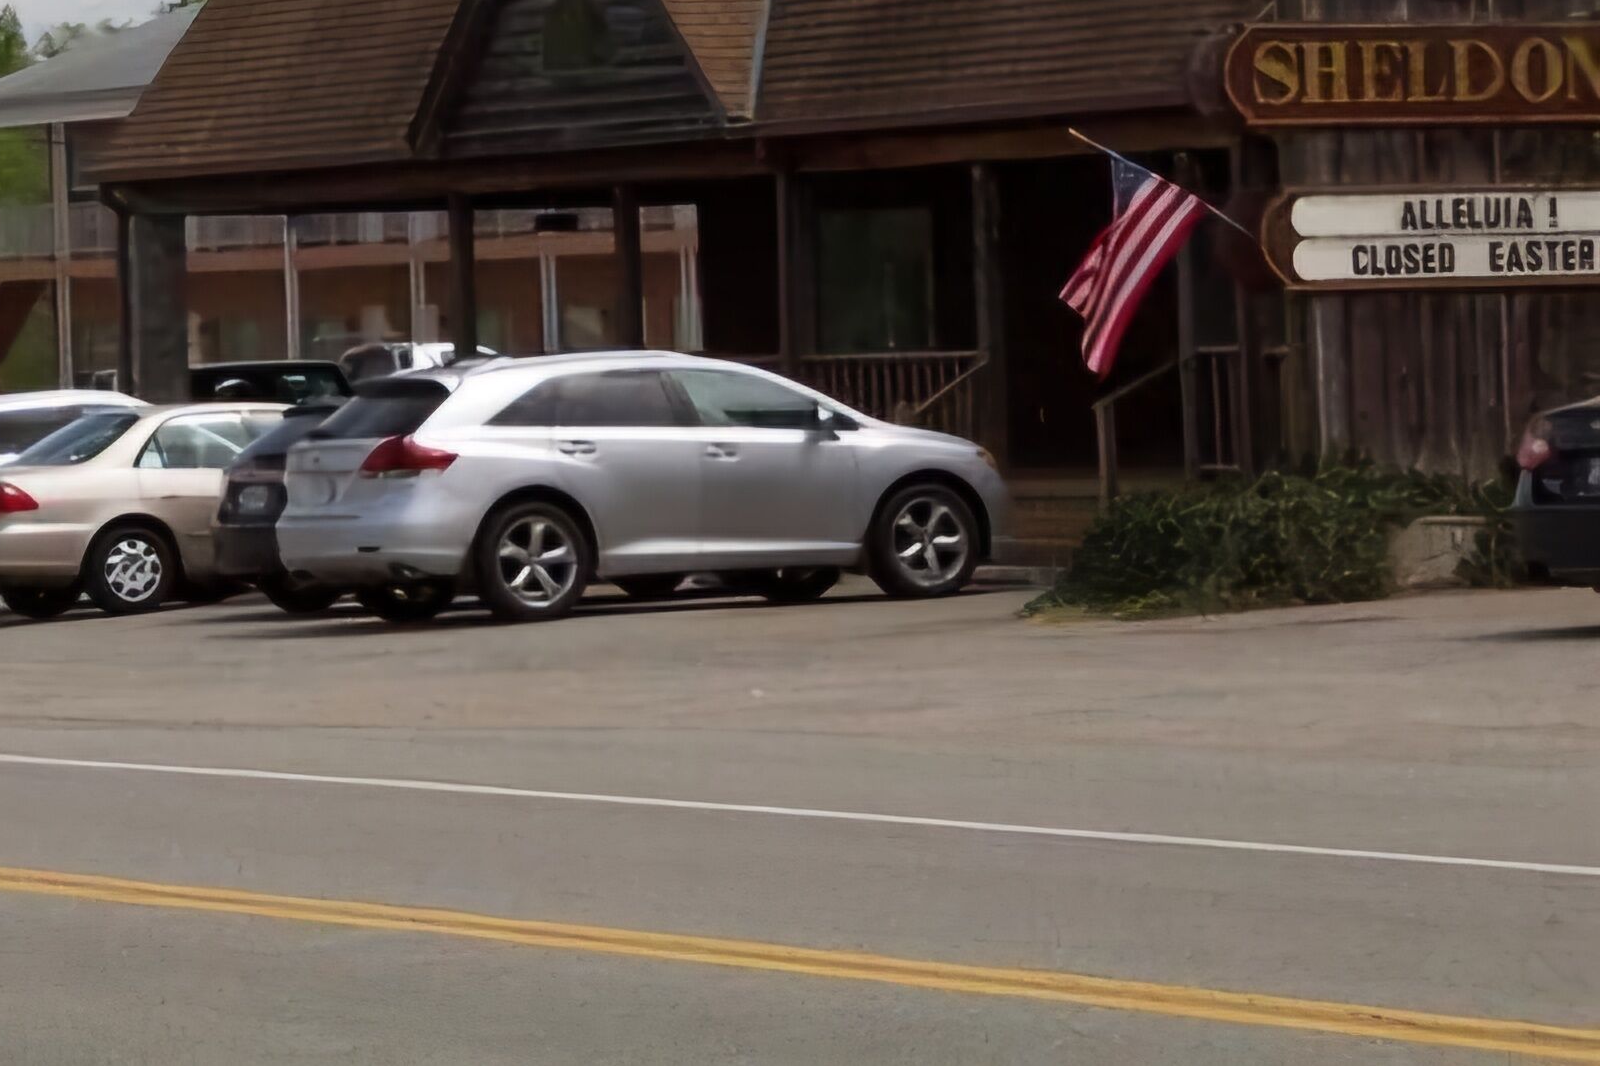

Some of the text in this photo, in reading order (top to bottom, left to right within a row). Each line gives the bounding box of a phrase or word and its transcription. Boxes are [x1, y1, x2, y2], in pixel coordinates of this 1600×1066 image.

[1401, 197, 1534, 230] ALLELUIA
[1352, 239, 1595, 276] CLOSED EASTER
